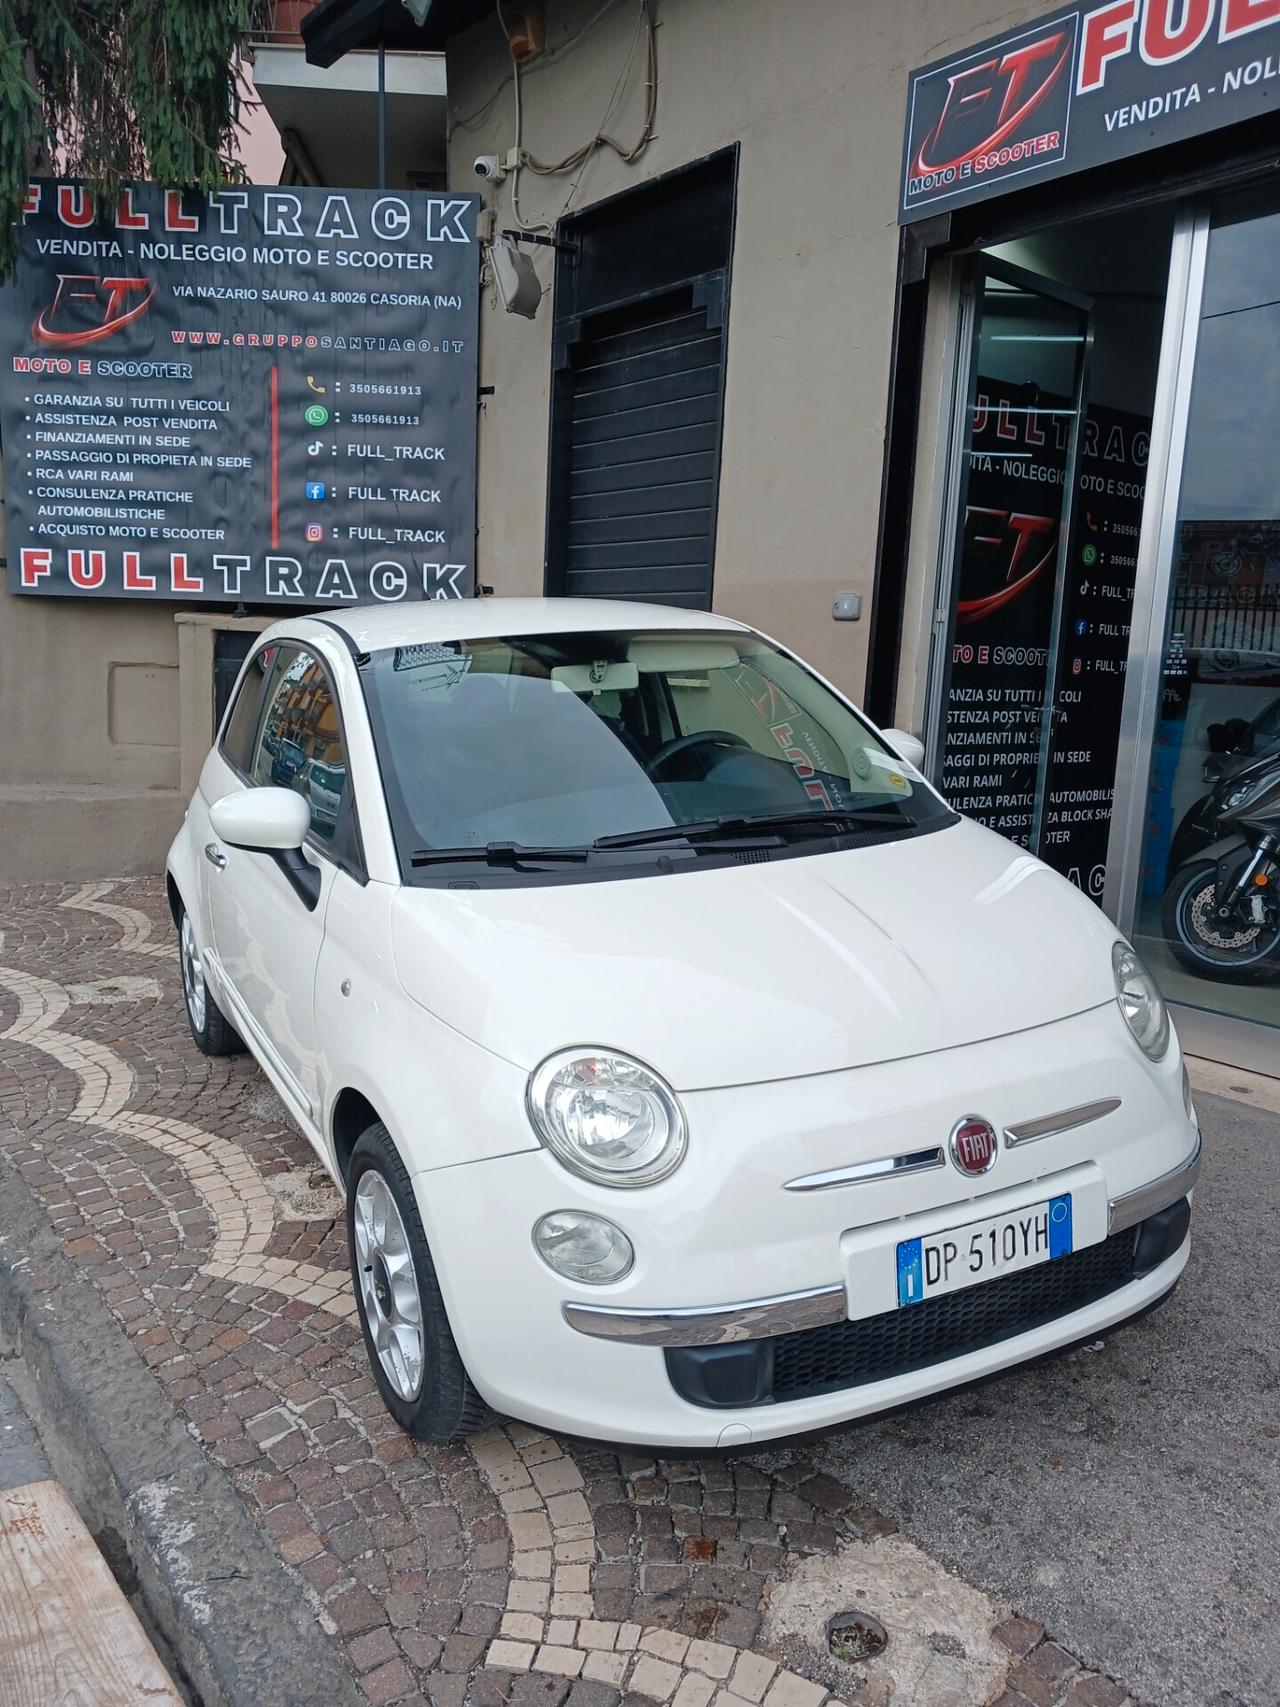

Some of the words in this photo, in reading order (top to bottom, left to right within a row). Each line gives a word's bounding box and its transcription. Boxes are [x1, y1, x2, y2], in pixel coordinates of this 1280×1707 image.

[1104, 84, 1201, 132] VENDITA
[1222, 56, 1280, 94] NOL
[908, 167, 957, 195] MOTO
[959, 159, 972, 180] E
[975, 131, 1060, 174] SCOOTER
[36, 239, 122, 258] VENDITA
[140, 243, 247, 263] NOLEGGIO
[253, 248, 311, 266] MOTO
[317, 250, 329, 265] E
[336, 251, 433, 270] SCOOTER
[172, 285, 194, 298] VIA
[197, 287, 258, 300] NAZARIO
[261, 289, 309, 302] SAURO
[312, 291, 327, 303] 41
[330, 292, 367, 304] 80026
[370, 293, 431, 307] CASORIA
[434, 294, 462, 310] (NA)
[13, 356, 73, 374] MOTO
[78, 359, 91, 375] E
[97, 360, 193, 379] SCOOTER
[349, 383, 422, 396] 3505661913
[34, 394, 102, 407] GARANZIA
[105, 396, 123, 408] SU
[131, 398, 168, 409] TUTTI
[170, 399, 175, 410] I
[178, 399, 230, 412] VEICOLI
[35, 412, 117, 427] ASSISTENZA
[124, 416, 158, 428] POST
[162, 417, 218, 430] VENDITA
[351, 413, 420, 425] 3505661913
[35, 431, 136, 446] FINANZIAMENTI
[139, 434, 152, 446] IN
[155, 435, 191, 448] SEDE
[35, 449, 113, 464] PASSAGGIO
[116, 452, 130, 464] DI
[133, 453, 198, 467] PROPIETA
[200, 455, 213, 467] IN
[216, 456, 252, 468] SEDE
[347, 444, 446, 461] FULL_TRACK
[36, 468, 64, 480] RCA
[67, 469, 97, 481] VARI
[101, 470, 134, 482] RAMI
[36, 486, 126, 501] CONSULENZA
[129, 489, 193, 503] PRATICHE
[38, 505, 166, 520] AUTOMOBILISTICHE
[38, 523, 105, 538] ACQUISTO
[109, 525, 147, 538] MOTO
[150, 527, 159, 539] E
[162, 528, 225, 541] SCOOTER
[349, 526, 445, 544] FULL_TRACK
[19, 548, 468, 600] FULLTRACK
[978, 645, 989, 664] E
[986, 689, 1001, 702] SU
[1004, 689, 1037, 702] TUTTI
[992, 710, 1022, 723] POST
[946, 731, 1011, 746] NZIAMENTI
[1014, 731, 1027, 744] IN
[943, 754, 975, 768] AGGI
[978, 753, 990, 767] DI
[1053, 751, 1064, 764] IN
[1067, 751, 1091, 763] SEDE
[943, 776, 970, 789] VARI
[973, 774, 1002, 787] RAMI
[1061, 809, 1093, 823] BLOCK
[961, 1132, 989, 1162] FIAT
[924, 1242, 957, 1286] DP
[968, 1213, 1049, 1273] 510YH
